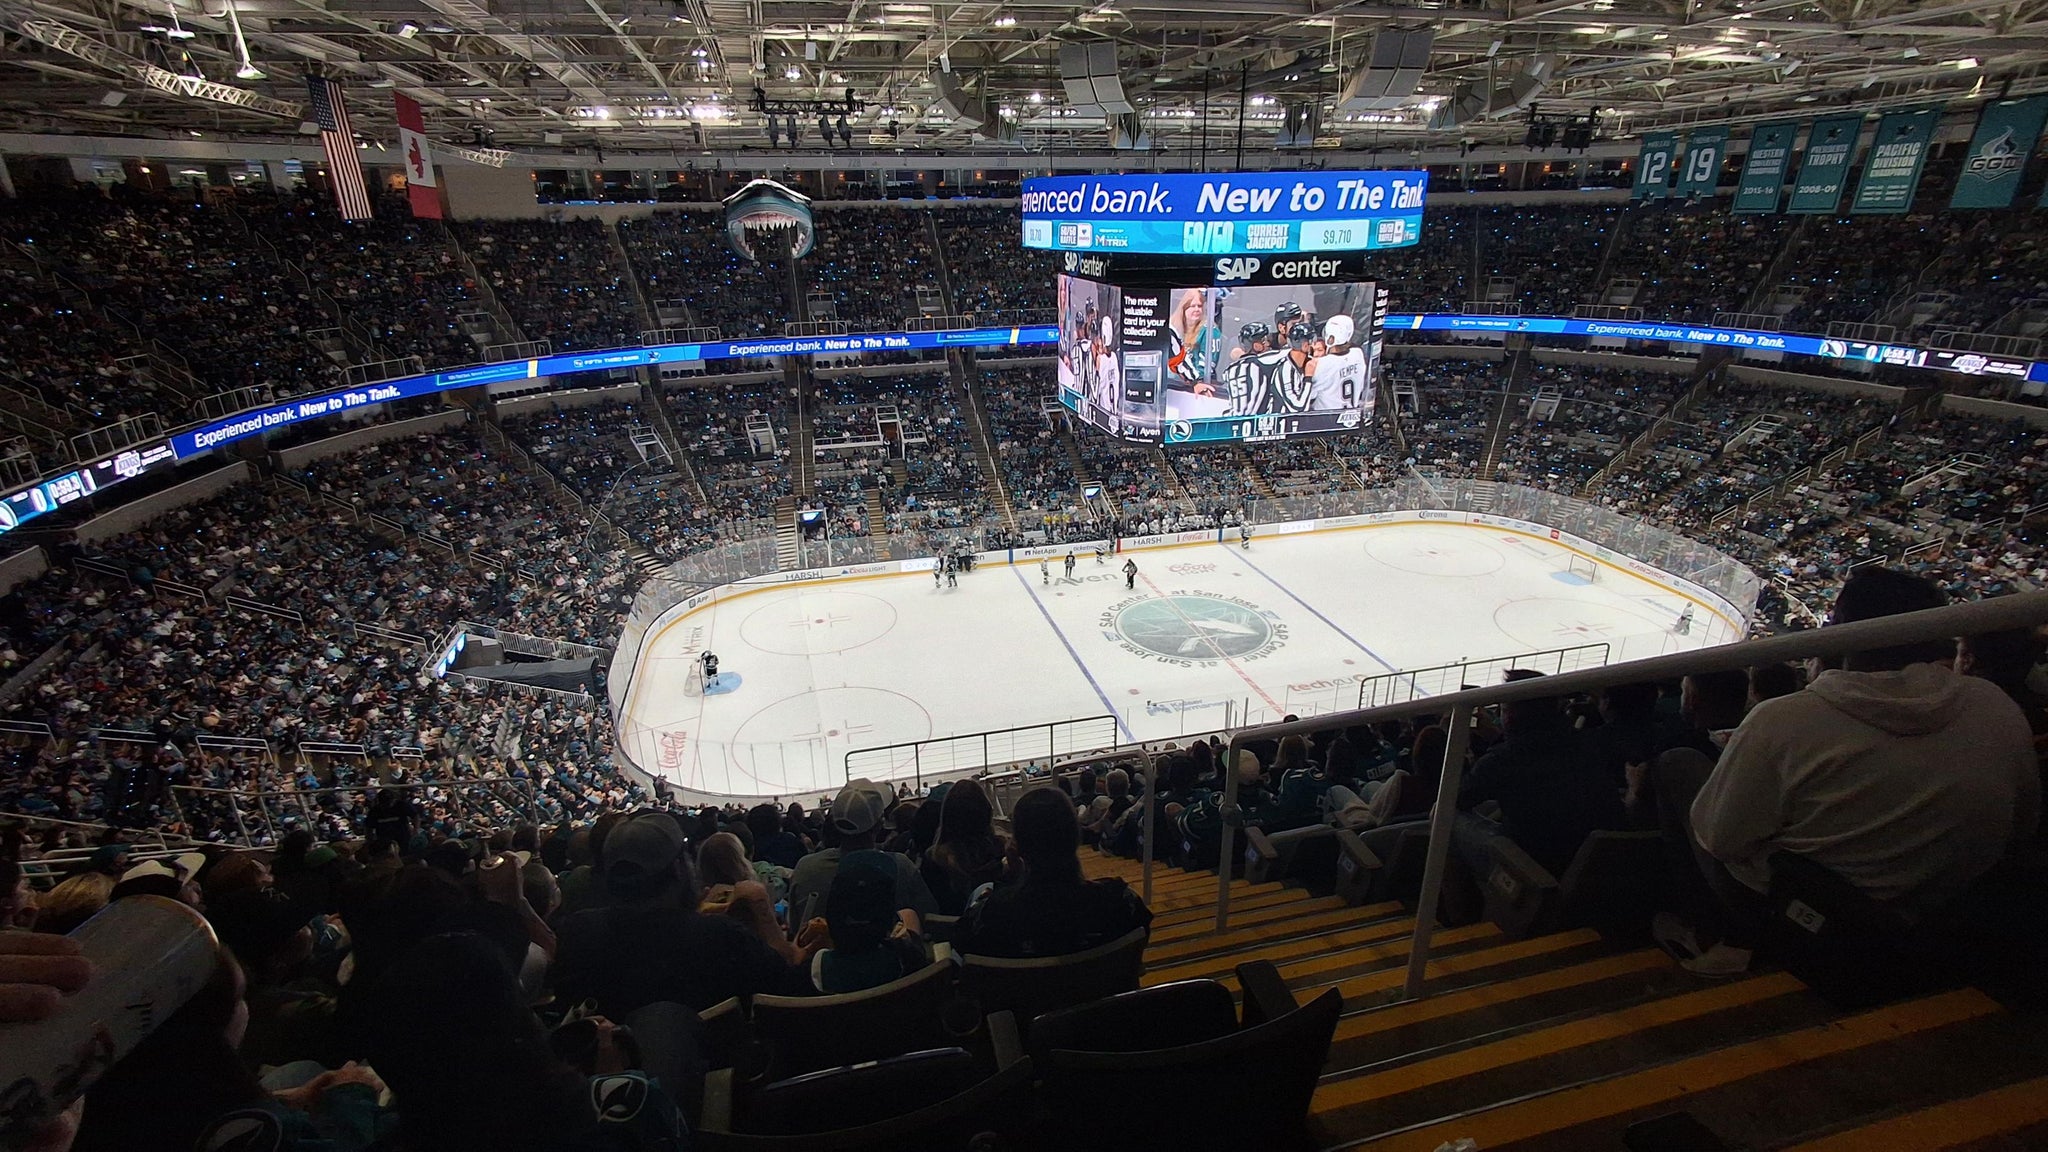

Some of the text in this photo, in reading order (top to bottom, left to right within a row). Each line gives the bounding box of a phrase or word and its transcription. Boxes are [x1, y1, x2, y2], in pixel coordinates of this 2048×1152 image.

[1876, 142, 1921, 157] PACIFIC
[1686, 148, 1715, 182] 19
[1808, 153, 1846, 165] TROPHY
[1872, 155, 1917, 169] DIVISION
[1641, 151, 1667, 184] 12
[1091, 182, 1173, 213] bank.
[1196, 182, 1282, 213] New
[1289, 182, 1325, 212] to
[1336, 179, 1384, 211] The
[1799, 184, 1837, 193] 2008-09
[1183, 221, 1234, 253] 50/50
[1247, 223, 1289, 237] CURRENT
[1246, 236, 1288, 250] JACKPOT
[1064, 251, 1078, 272] SAP
[1216, 256, 1342, 280] SAP center
[1124, 296, 1158, 306] The most
[1123, 306, 1154, 316] valuable
[1123, 317, 1165, 328] card in your
[1123, 327, 1157, 337] collection
[1586, 323, 1786, 348] Experienced bank. New to The Tank.
[729, 336, 910, 356] Experienced bank. New to The Tank.
[1866, 345, 1877, 360] 0
[1918, 351, 1928, 367] 1
[1956, 358, 1983, 368] KINGS
[1230, 376, 1247, 397] 65
[1342, 379, 1354, 409] 9
[194, 385, 400, 448] Experienced bank. New to The Tank.
[1140, 427, 1161, 437] Aven
[1242, 421, 1251, 437] 0
[1279, 418, 1286, 434] 1
[118, 456, 140, 472] KINGS
[29, 488, 47, 513] 0
[82, 468, 97, 491] 1
[1418, 511, 1447, 520] Corona
[1134, 536, 1162, 545] MARSH
[1032, 547, 1057, 555] NetApp
[786, 571, 820, 581] MARSH
[1054, 572, 1118, 587] Aven
[1099, 612, 1114, 628] SAP
[1108, 593, 1150, 612] Center
[1193, 589, 1224, 599] San
[1226, 596, 1260, 610] Jose
[1120, 623, 1289, 669] SAP Center at San Jose
